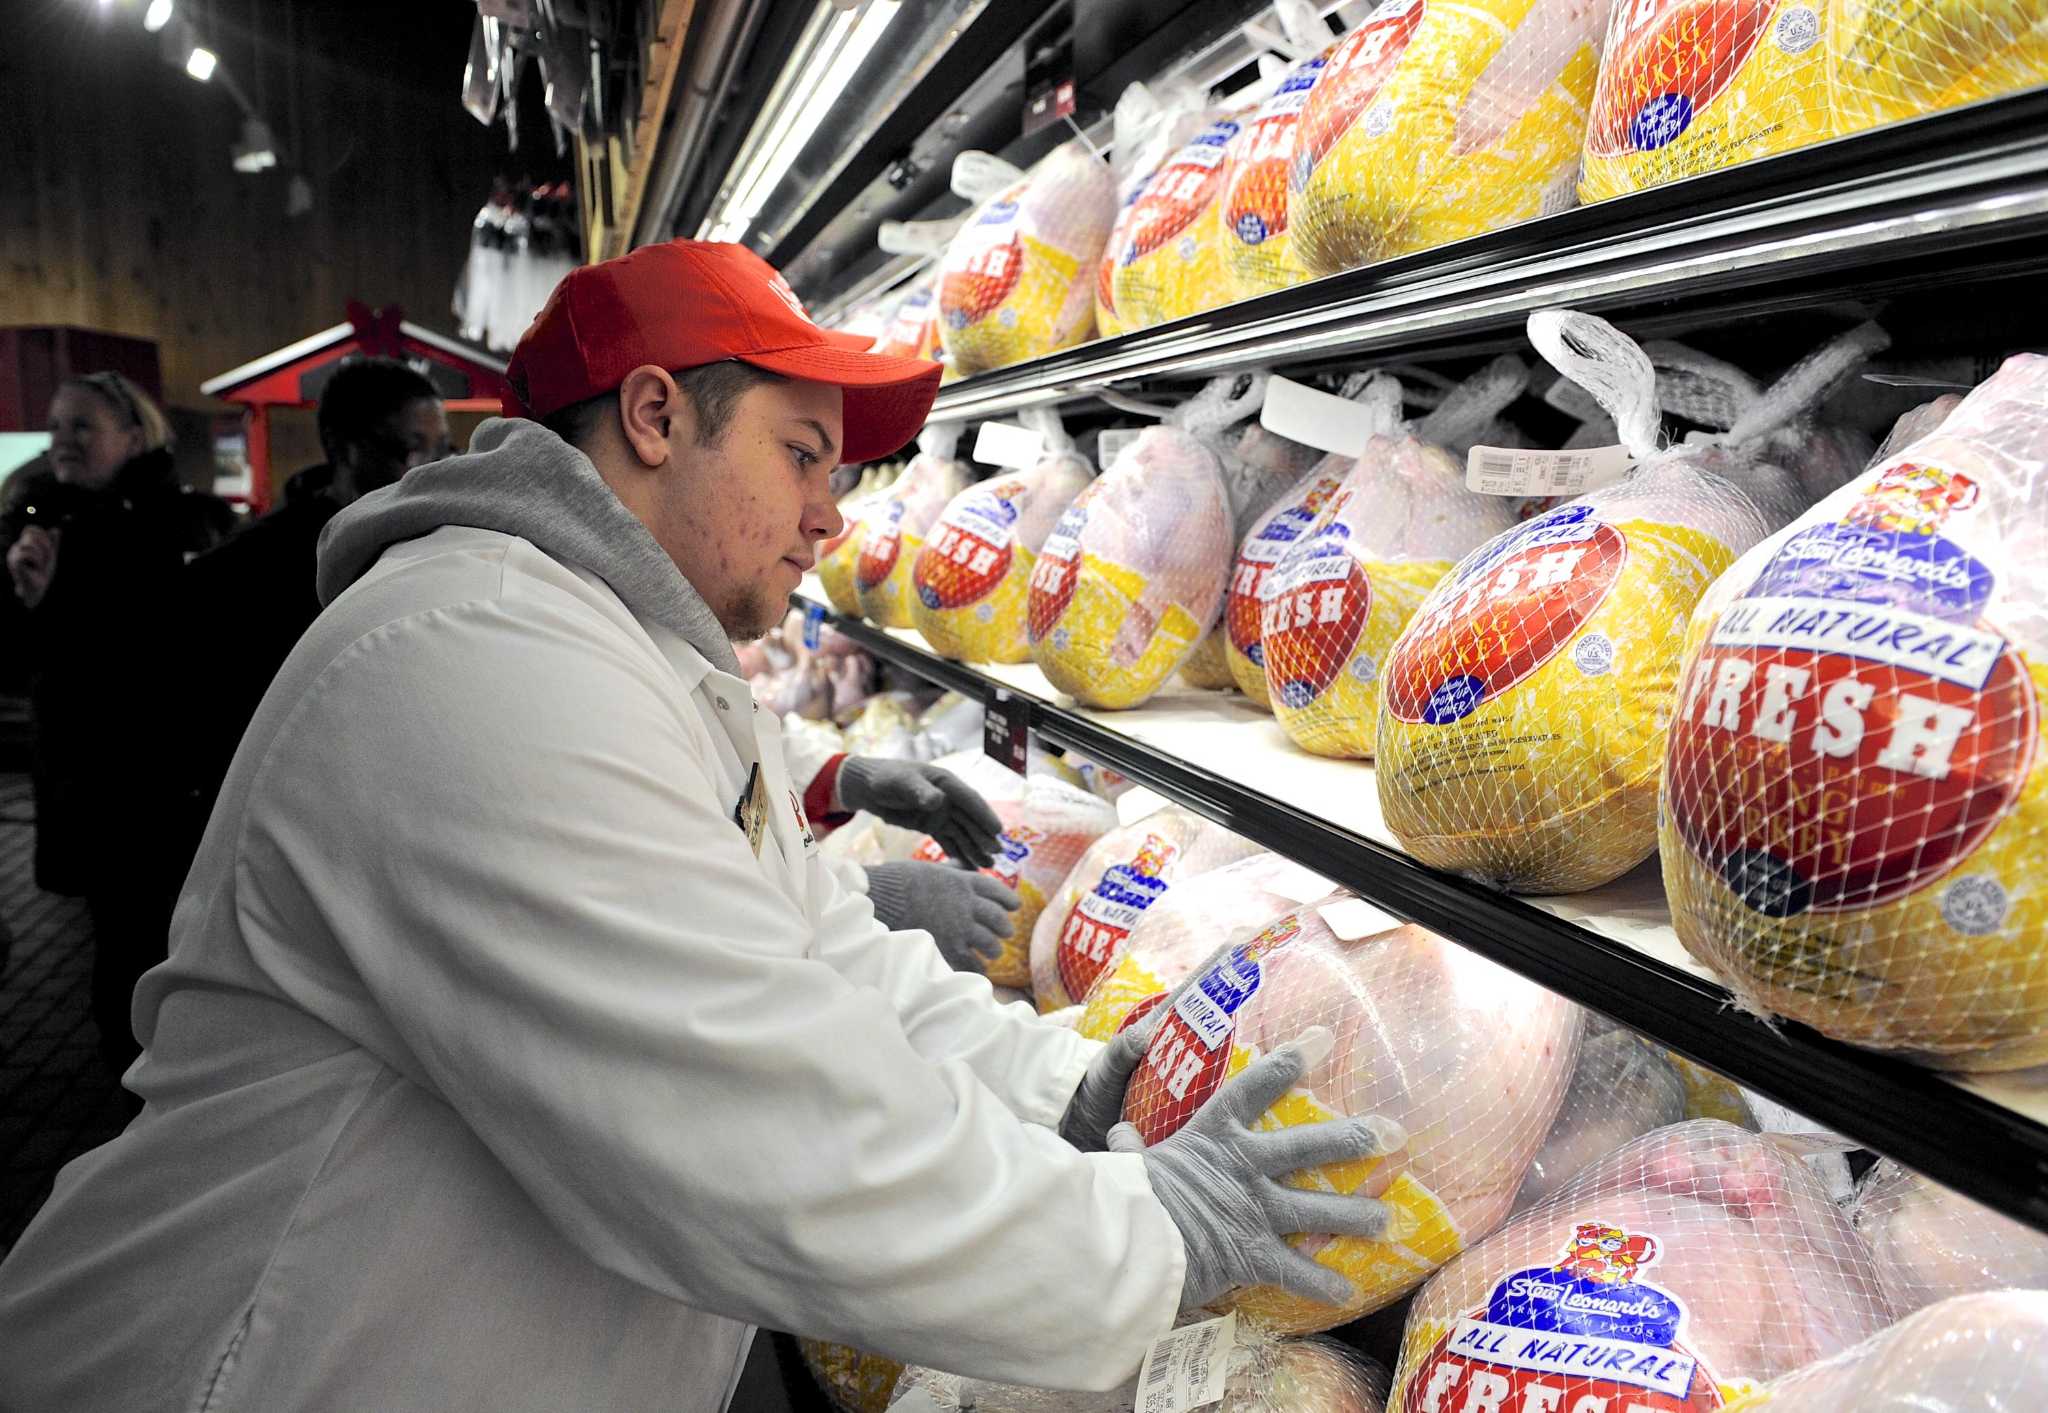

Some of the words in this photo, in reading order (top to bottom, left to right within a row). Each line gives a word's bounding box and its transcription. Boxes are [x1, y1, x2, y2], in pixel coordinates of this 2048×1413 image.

[1063, 914, 1129, 968] FRES
[1508, 1278, 1561, 1301] Stew
[1555, 1282, 1662, 1319] Leonard's
[1458, 1326, 1506, 1353] ALL
